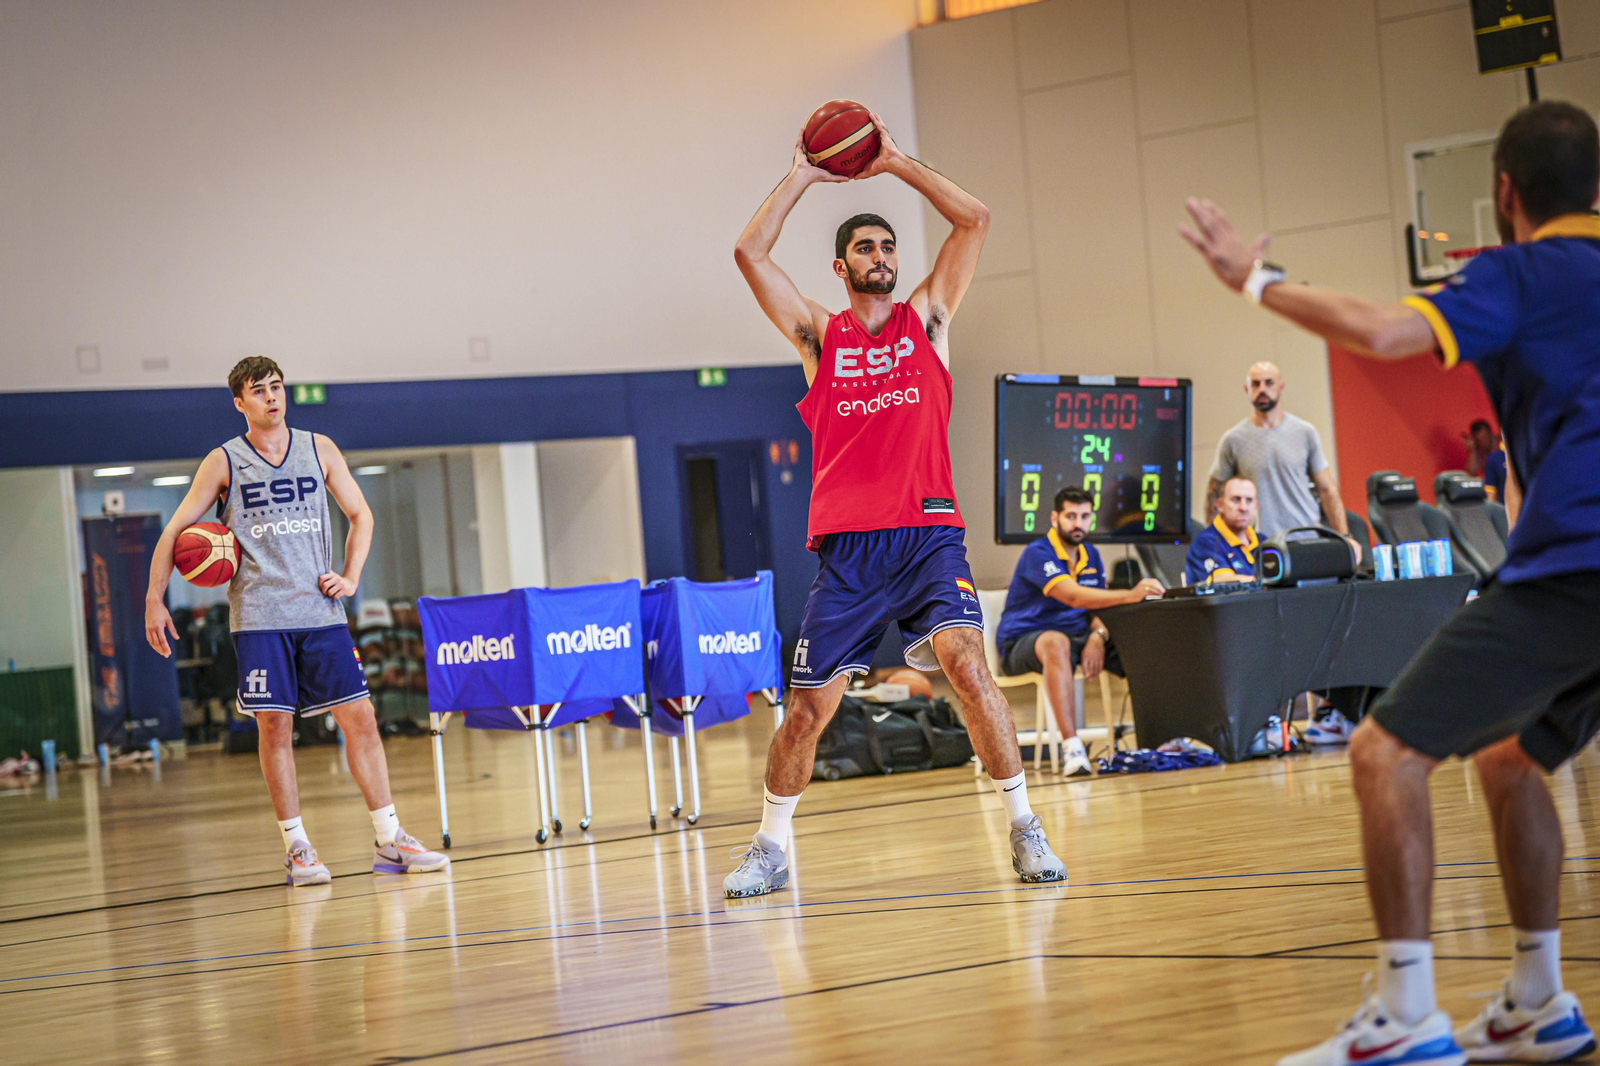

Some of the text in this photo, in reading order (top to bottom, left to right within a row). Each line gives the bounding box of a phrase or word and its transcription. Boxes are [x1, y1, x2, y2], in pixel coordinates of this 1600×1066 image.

[840, 145, 873, 168] molten
[834, 336, 915, 378] ESP
[832, 369, 922, 388] BASKETBALL
[837, 387, 920, 417] endesa
[1054, 392, 1138, 431] 00:00
[1081, 434, 1111, 464] 24
[240, 476, 318, 510] ESP
[1020, 473, 1041, 512] 0
[1140, 473, 1160, 511] 0
[243, 506, 315, 519] BASKETBAL
[1024, 512, 1035, 532] 0
[1144, 512, 1155, 532] 0
[250, 516, 322, 539] endesa
[437, 633, 516, 666] molten
[546, 622, 631, 656] molten
[698, 630, 762, 655] molten
[245, 668, 268, 693] fi
[243, 691, 272, 699] network
